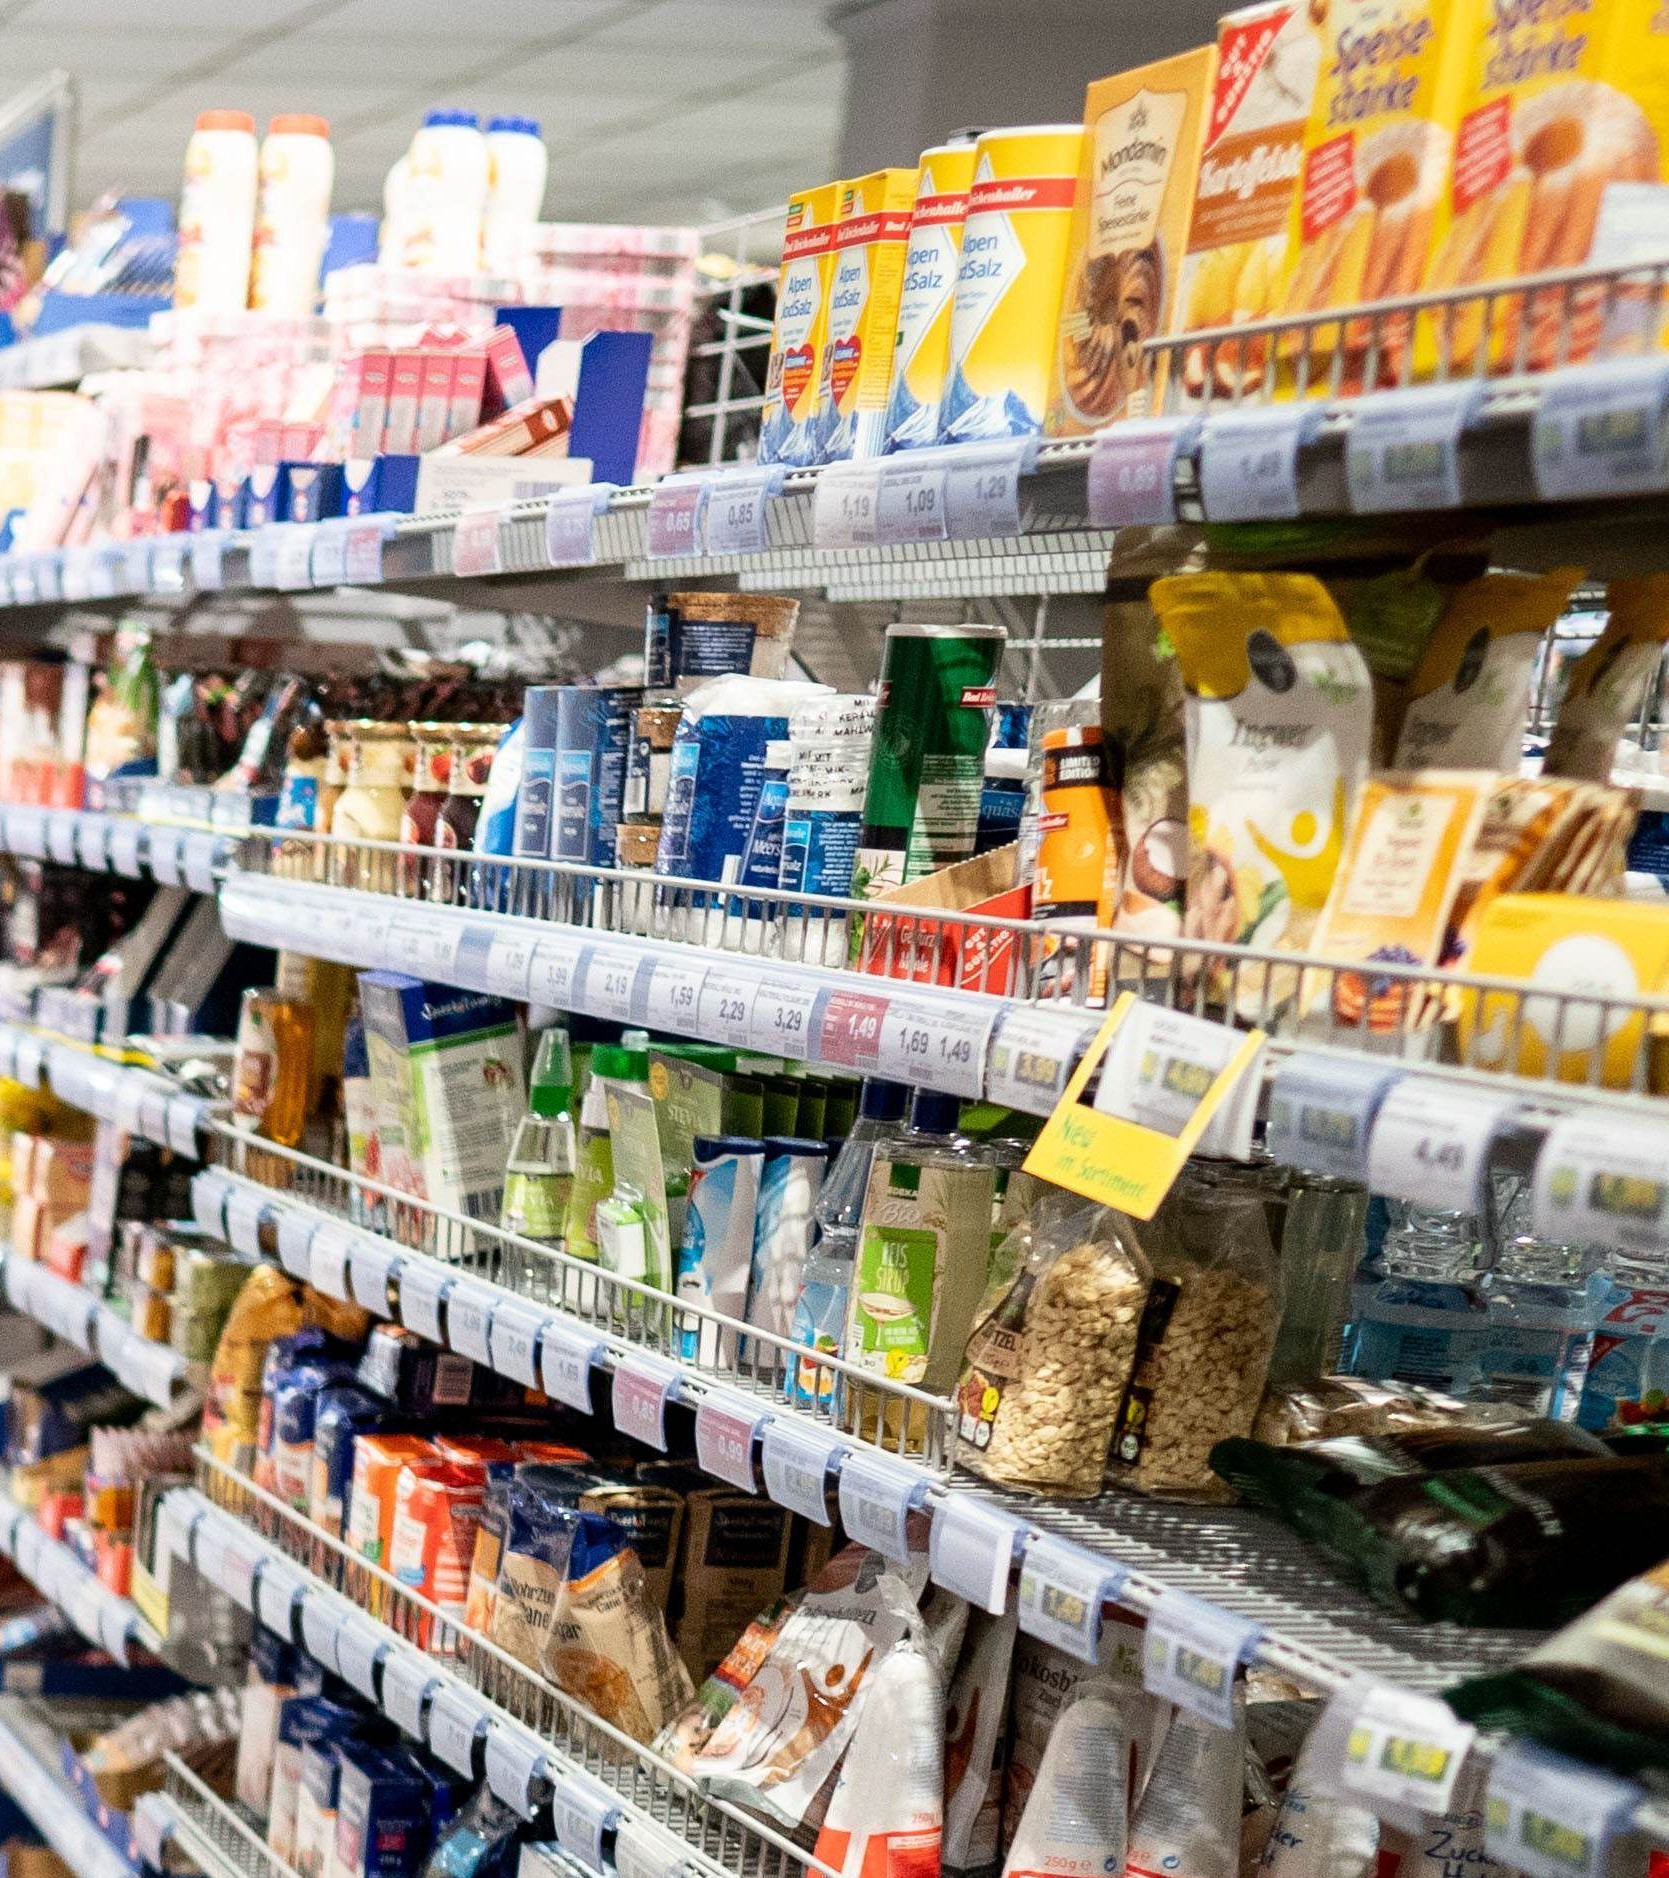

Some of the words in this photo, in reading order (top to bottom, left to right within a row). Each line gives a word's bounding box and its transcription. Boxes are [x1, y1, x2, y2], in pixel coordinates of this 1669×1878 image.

[1100, 137, 1167, 175] Mondamin
[975, 476, 1007, 500] 1,29
[841, 496, 871, 520] 1,19
[905, 488, 935, 515] 1,09
[666, 511, 691, 533] 0,65
[728, 504, 754, 528] 0,85
[605, 975, 628, 995] 2,19
[669, 985, 694, 1006] 1,59
[719, 999, 746, 1022] 2,29
[774, 1007, 803, 1031] 3,29
[848, 1014, 877, 1039] 1,49
[899, 1027, 930, 1055] 1,69
[940, 1036, 971, 1063] 1,49
